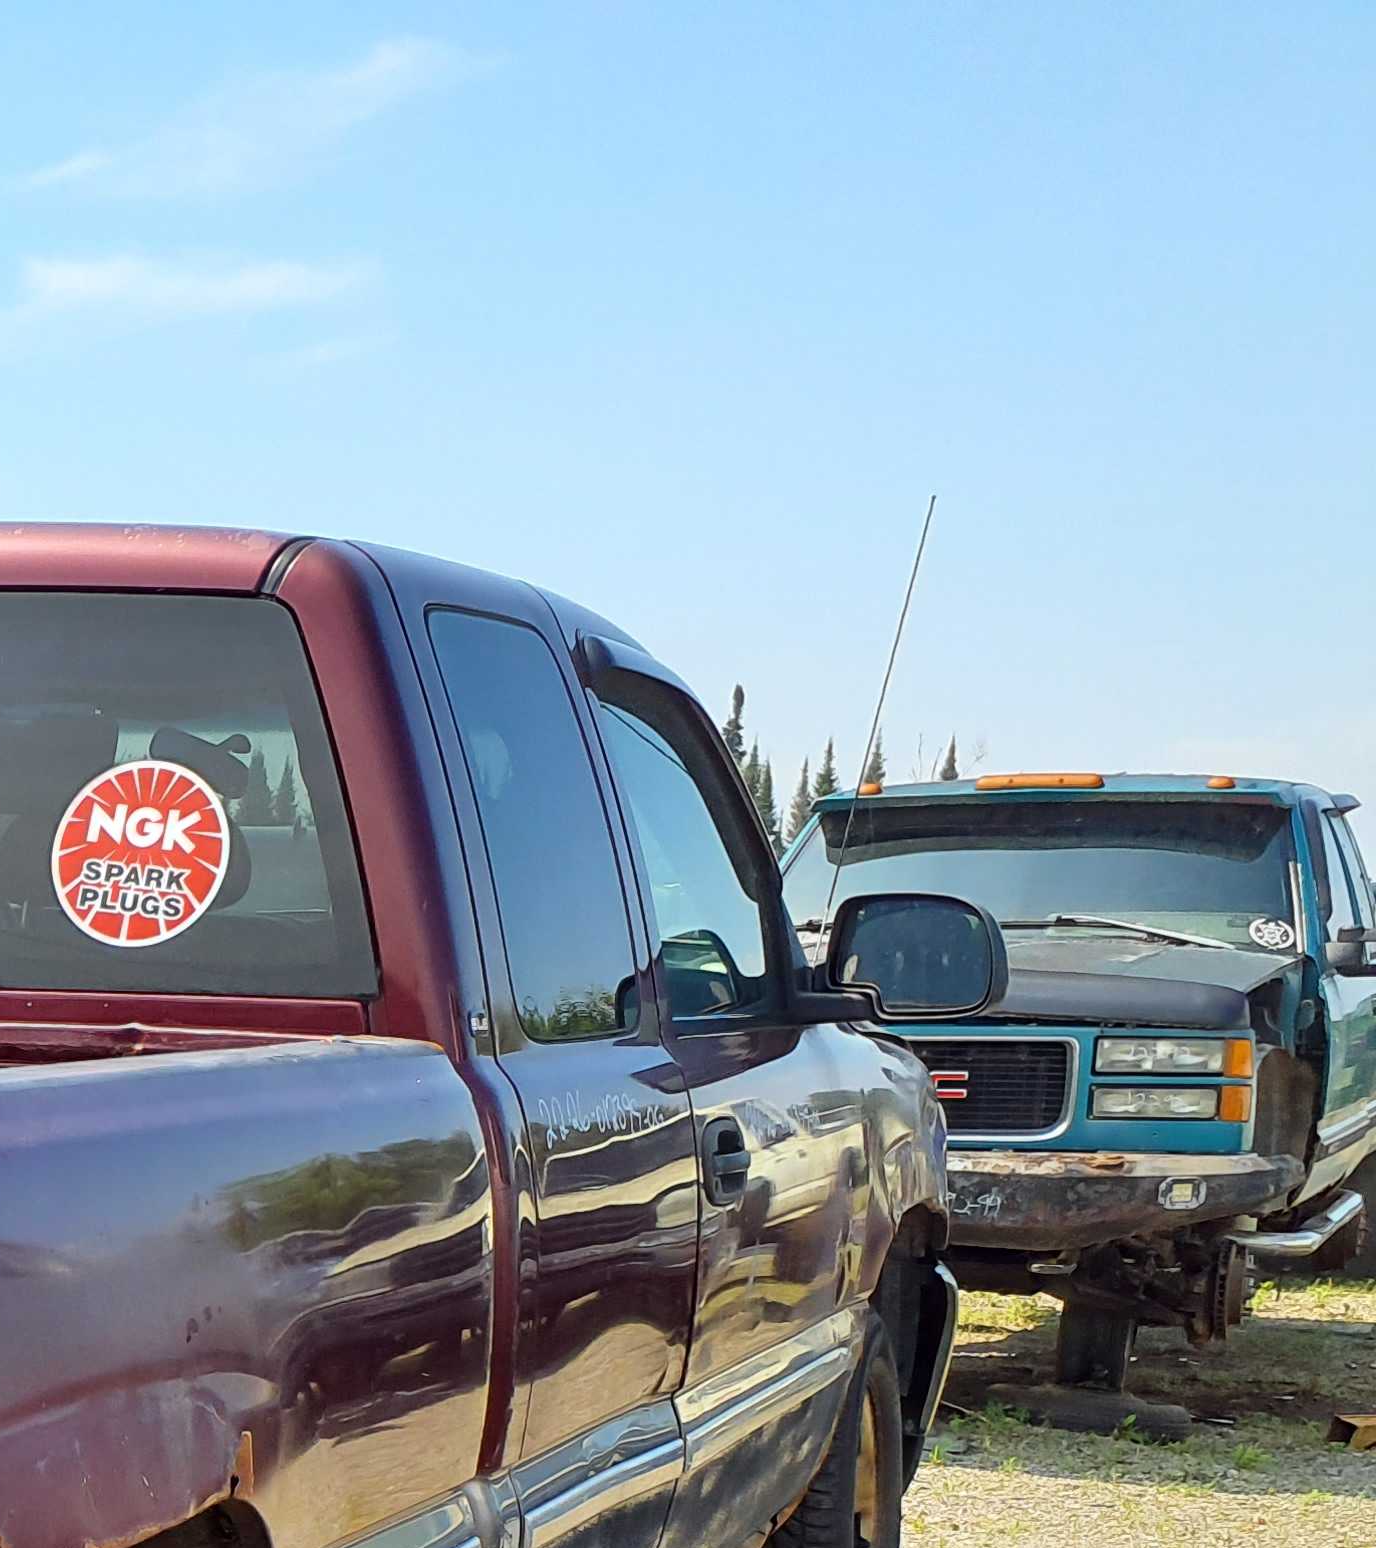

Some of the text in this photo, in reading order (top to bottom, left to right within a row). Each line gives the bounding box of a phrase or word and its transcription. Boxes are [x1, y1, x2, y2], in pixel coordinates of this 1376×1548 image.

[85, 802, 202, 855] NGK
[82, 859, 190, 893] SPARK
[77, 887, 184, 919] PLUGS
